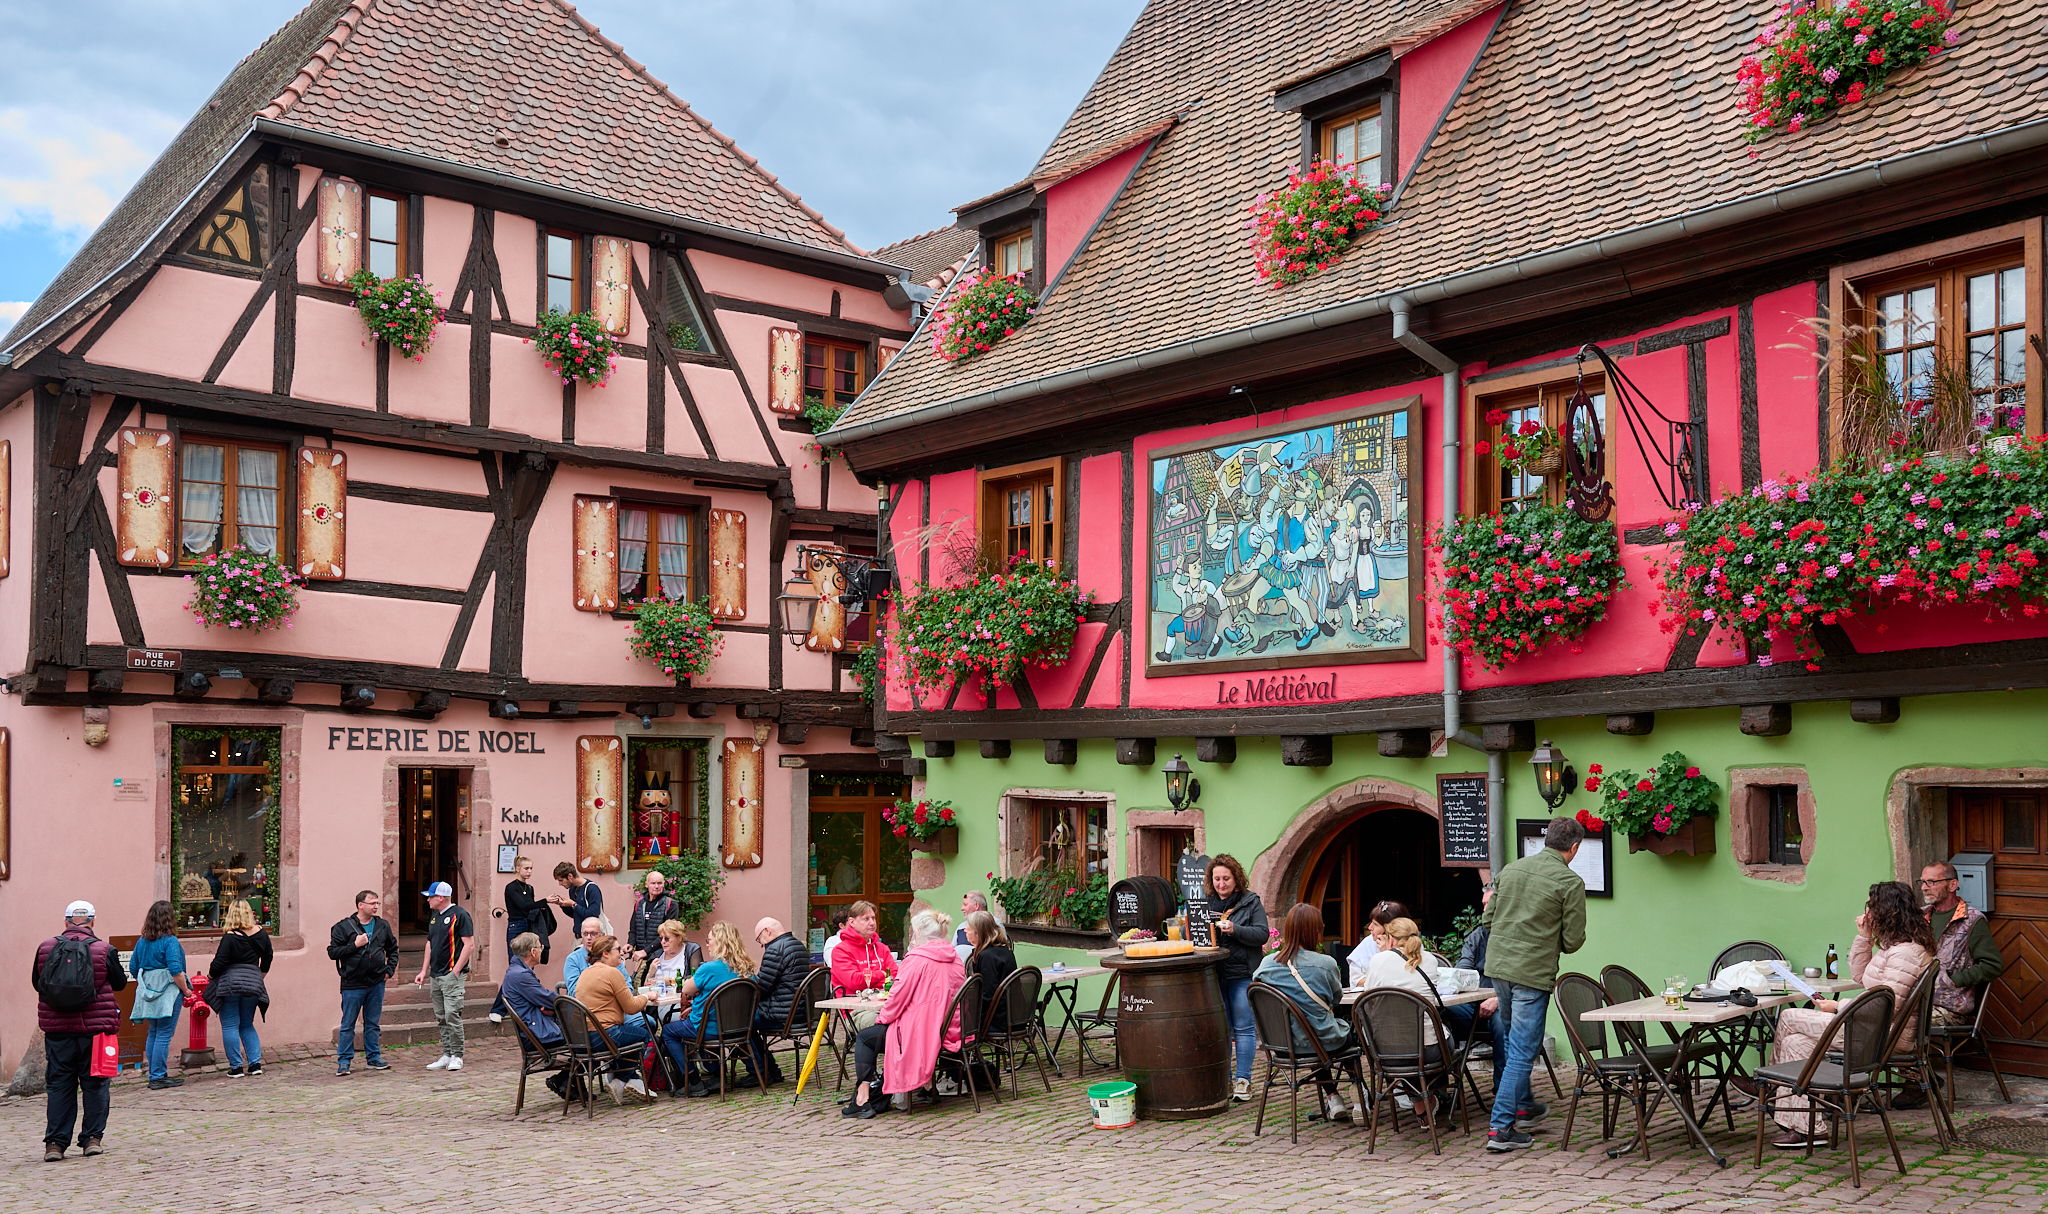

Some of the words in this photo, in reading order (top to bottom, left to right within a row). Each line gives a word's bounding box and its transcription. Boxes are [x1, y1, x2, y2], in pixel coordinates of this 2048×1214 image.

[134, 658, 147, 667] DU
[150, 659, 175, 668] CERF
[145, 651, 164, 659] RUE
[1216, 680, 1239, 704] Le
[1244, 672, 1337, 702] Médiéval
[328, 726, 429, 751] FEERIE
[437, 729, 470, 752] DE
[478, 730, 546, 754] NOEL
[501, 807, 540, 823] Kathe
[501, 829, 566, 845] Wohlfahrt
